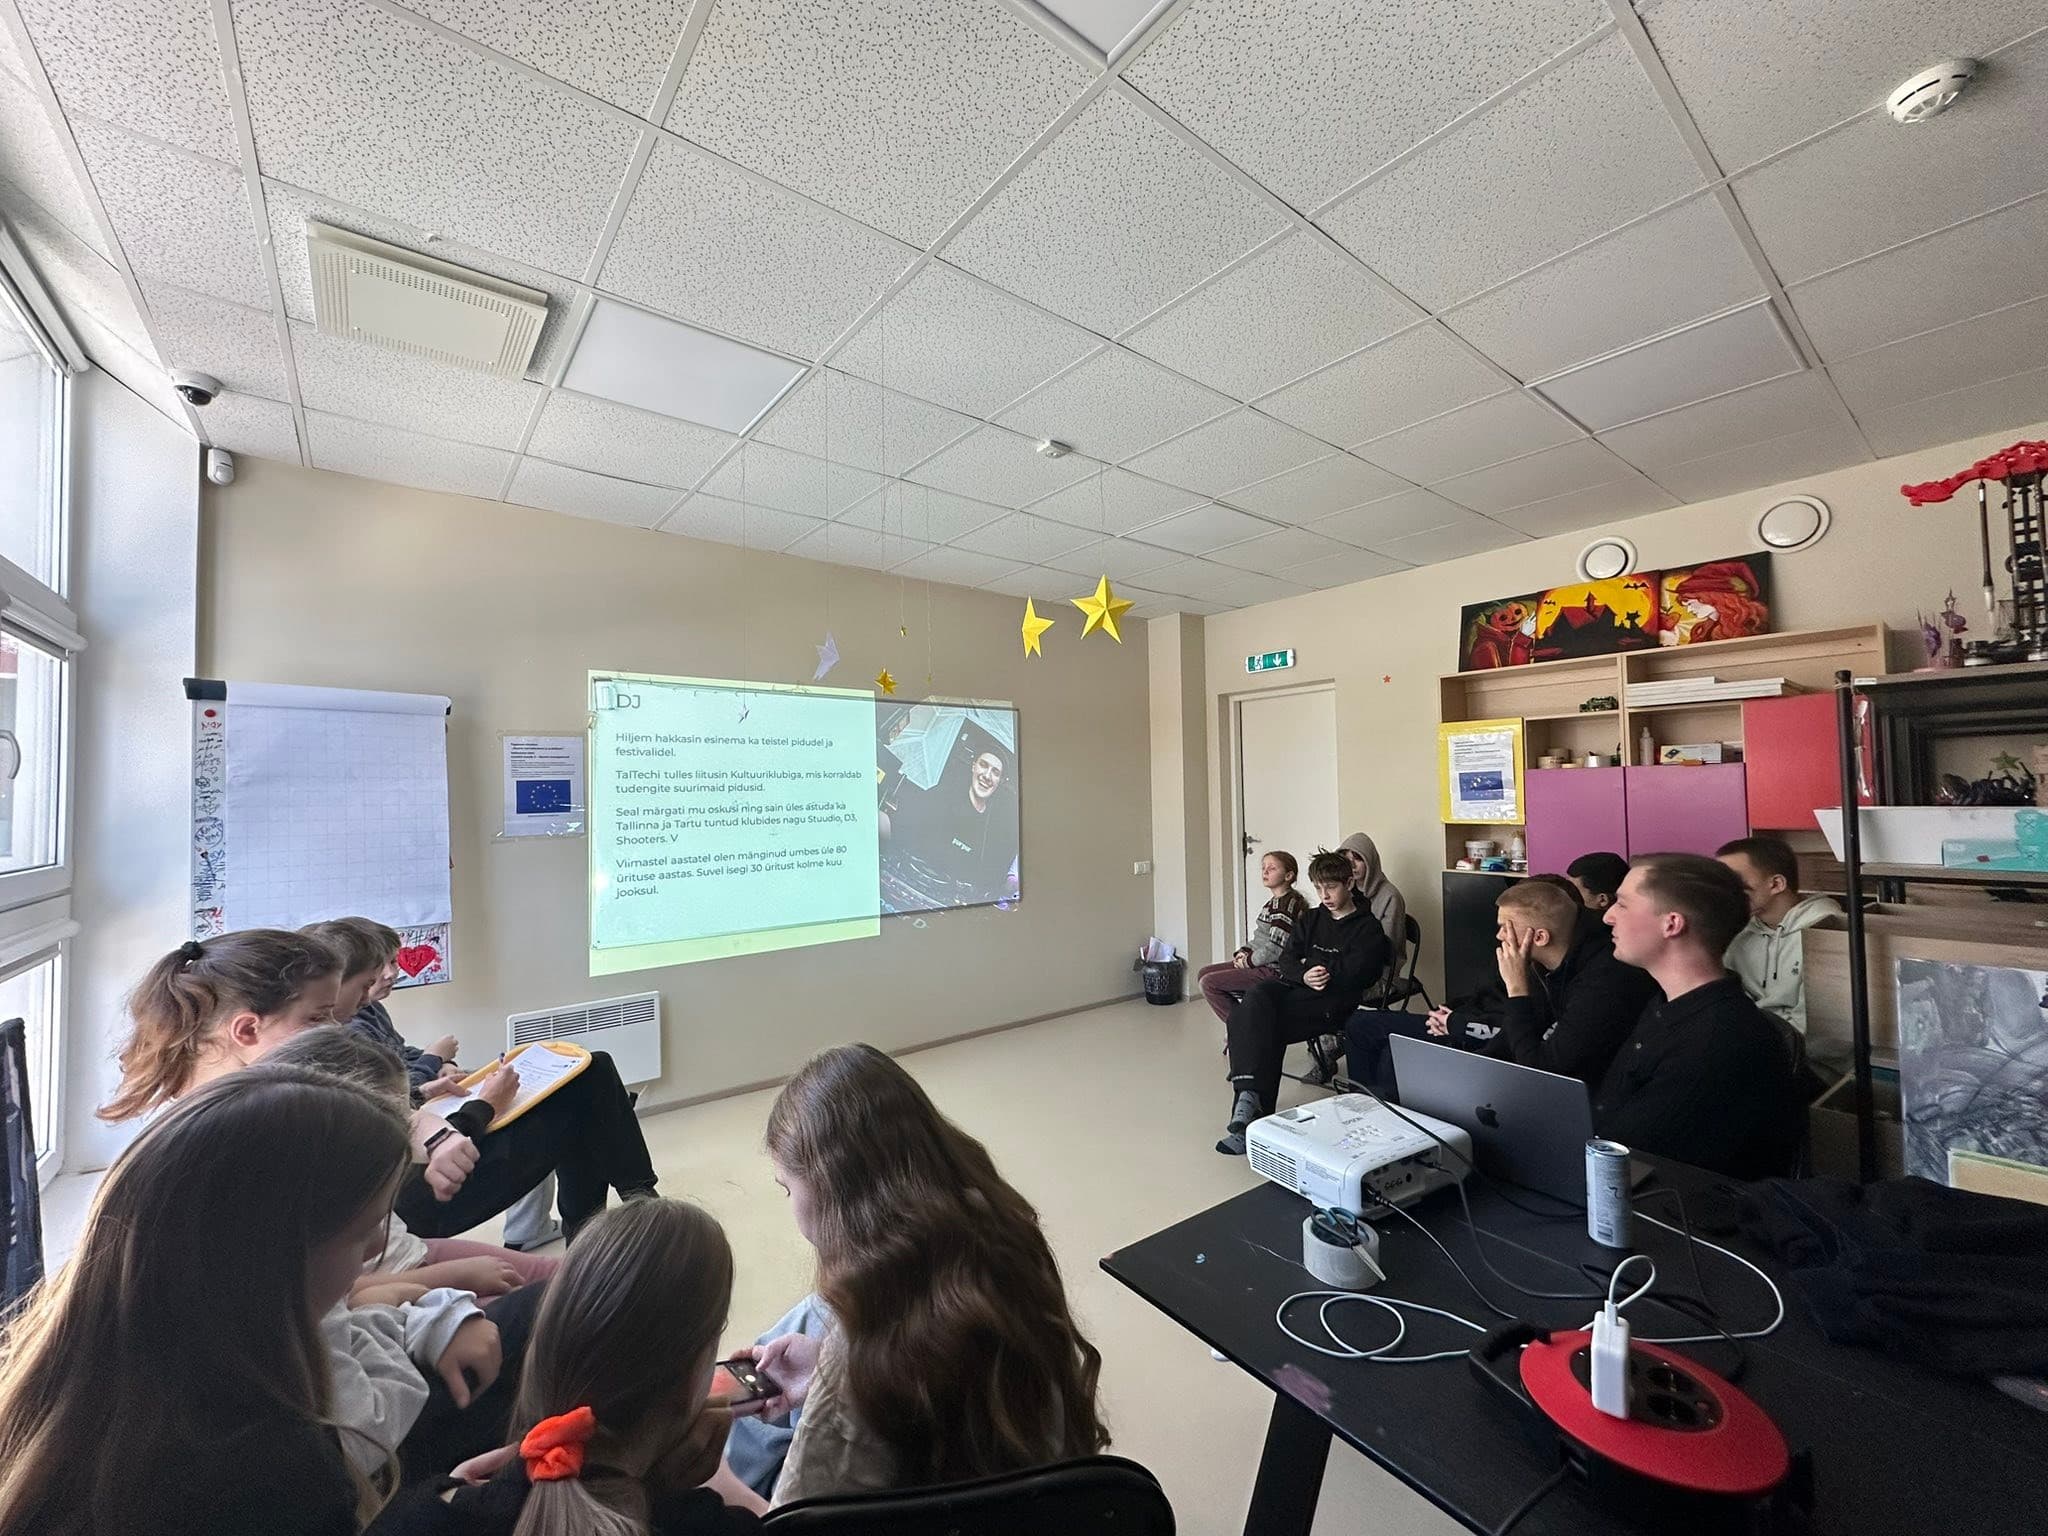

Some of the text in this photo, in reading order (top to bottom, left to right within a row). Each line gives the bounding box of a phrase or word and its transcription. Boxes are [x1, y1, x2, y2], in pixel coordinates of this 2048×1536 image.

[616, 694, 641, 709] DJ
[616, 732, 834, 748] Hiljem hakkasin esinema ka teistel pidudel ja
[616, 746, 676, 757] festivalidel.
[616, 770, 660, 780] TalTechi
[664, 770, 693, 779] tulles
[696, 770, 728, 779] liitusin
[823, 771, 862, 779] korraldab
[616, 784, 766, 794] tudengite suurimaid pidusid.
[616, 807, 639, 817] Seal
[642, 806, 685, 817] märgati
[708, 804, 739, 814] oskusi
[741, 804, 763, 814] ning
[765, 804, 783, 812] sain
[786, 803, 804, 812] üles
[836, 802, 846, 810] ka
[616, 821, 659, 831] Tallinna
[661, 820, 672, 831] ja
[674, 820, 702, 828] Tartu
[704, 818, 739, 827] tuntud
[741, 816, 780, 826] klubides
[783, 817, 806, 825] nagu
[616, 834, 679, 845] Shooters. V
[616, 845, 847, 868] Viimastel aastatel olen mänginud umbes üle 80
[616, 859, 842, 883] ürituse aastas. Suvel isegi 30 üritust kolme kuu
[615, 885, 659, 900] jooksul.
